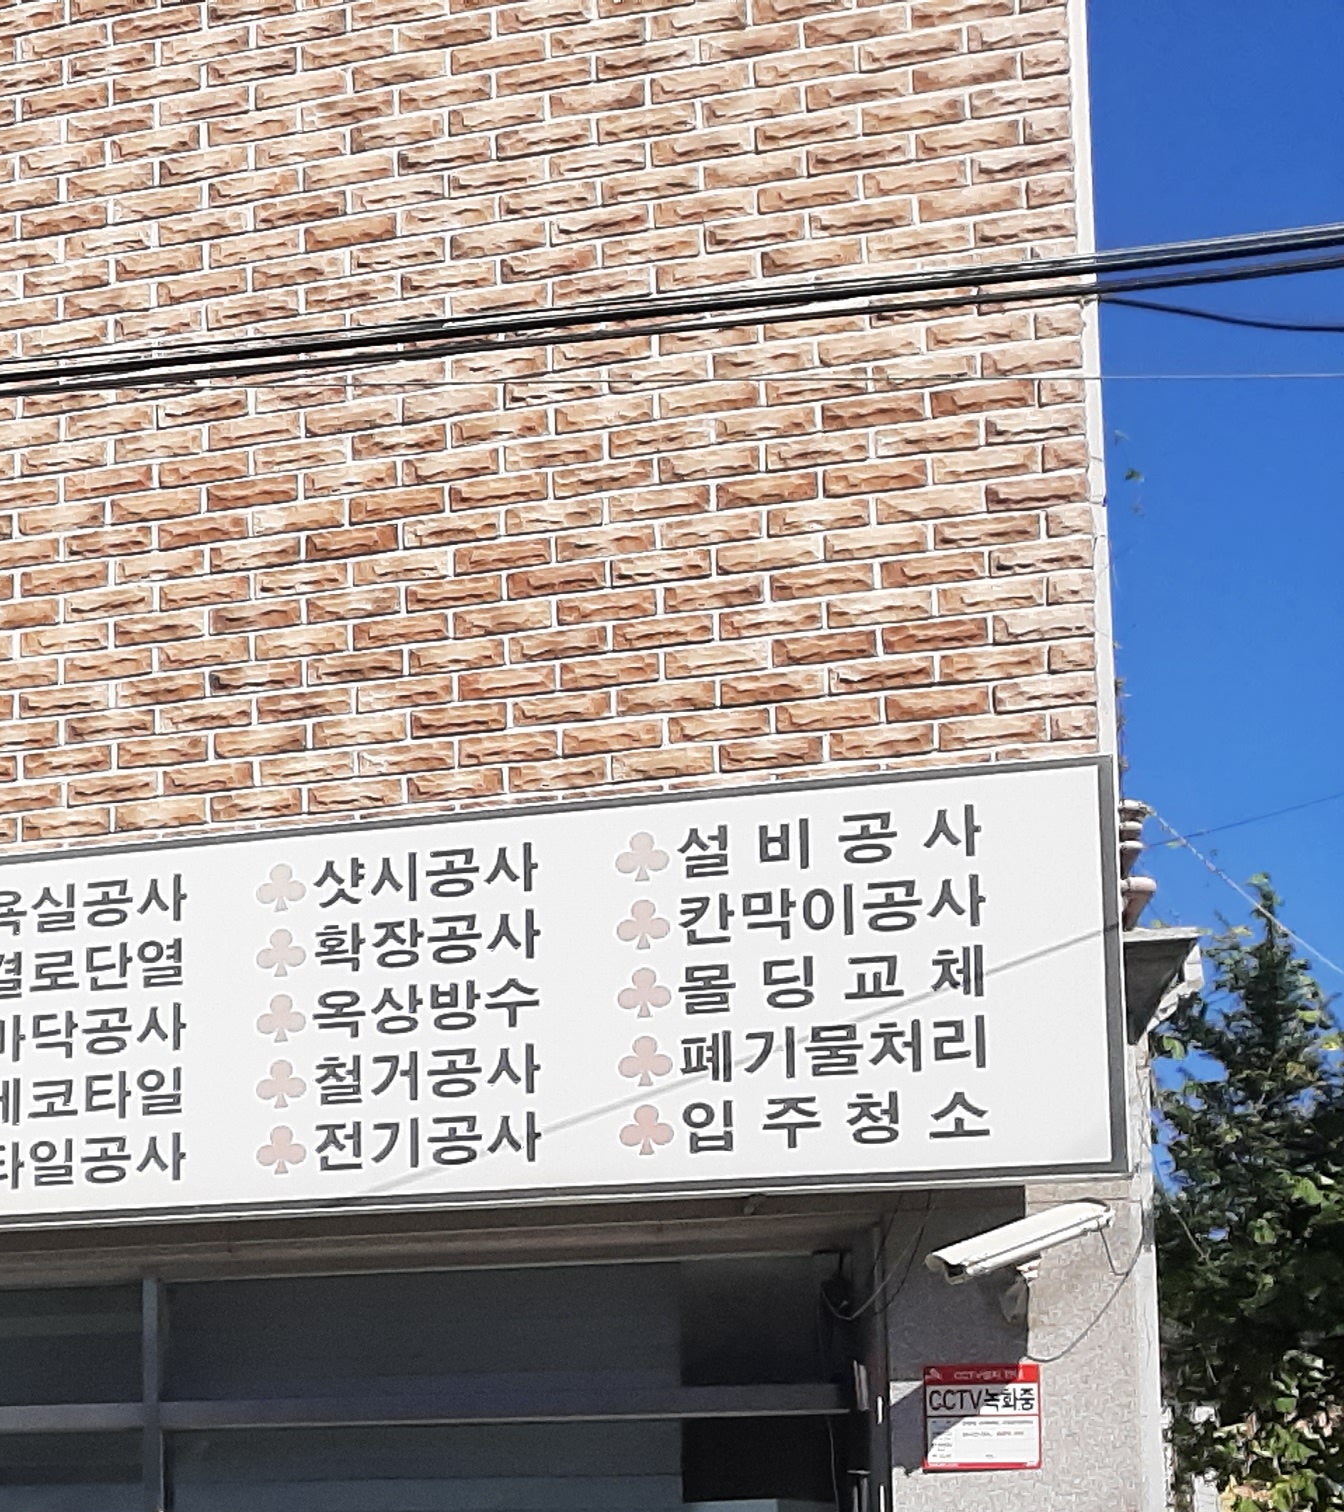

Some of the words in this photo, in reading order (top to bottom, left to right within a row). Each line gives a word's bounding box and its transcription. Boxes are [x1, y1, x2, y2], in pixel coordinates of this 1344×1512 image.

[312, 841, 539, 908] 샷시공사
[313, 908, 542, 972] 확장공사
[677, 875, 987, 946] 칸막이공사
[312, 977, 542, 1041] 옥상방수
[312, 1042, 542, 1106] 철거공사
[679, 1013, 988, 1085] 폐기물처리
[313, 1110, 542, 1175] 전기공사
[929, 1387, 1035, 1412] CCTV녹화중
